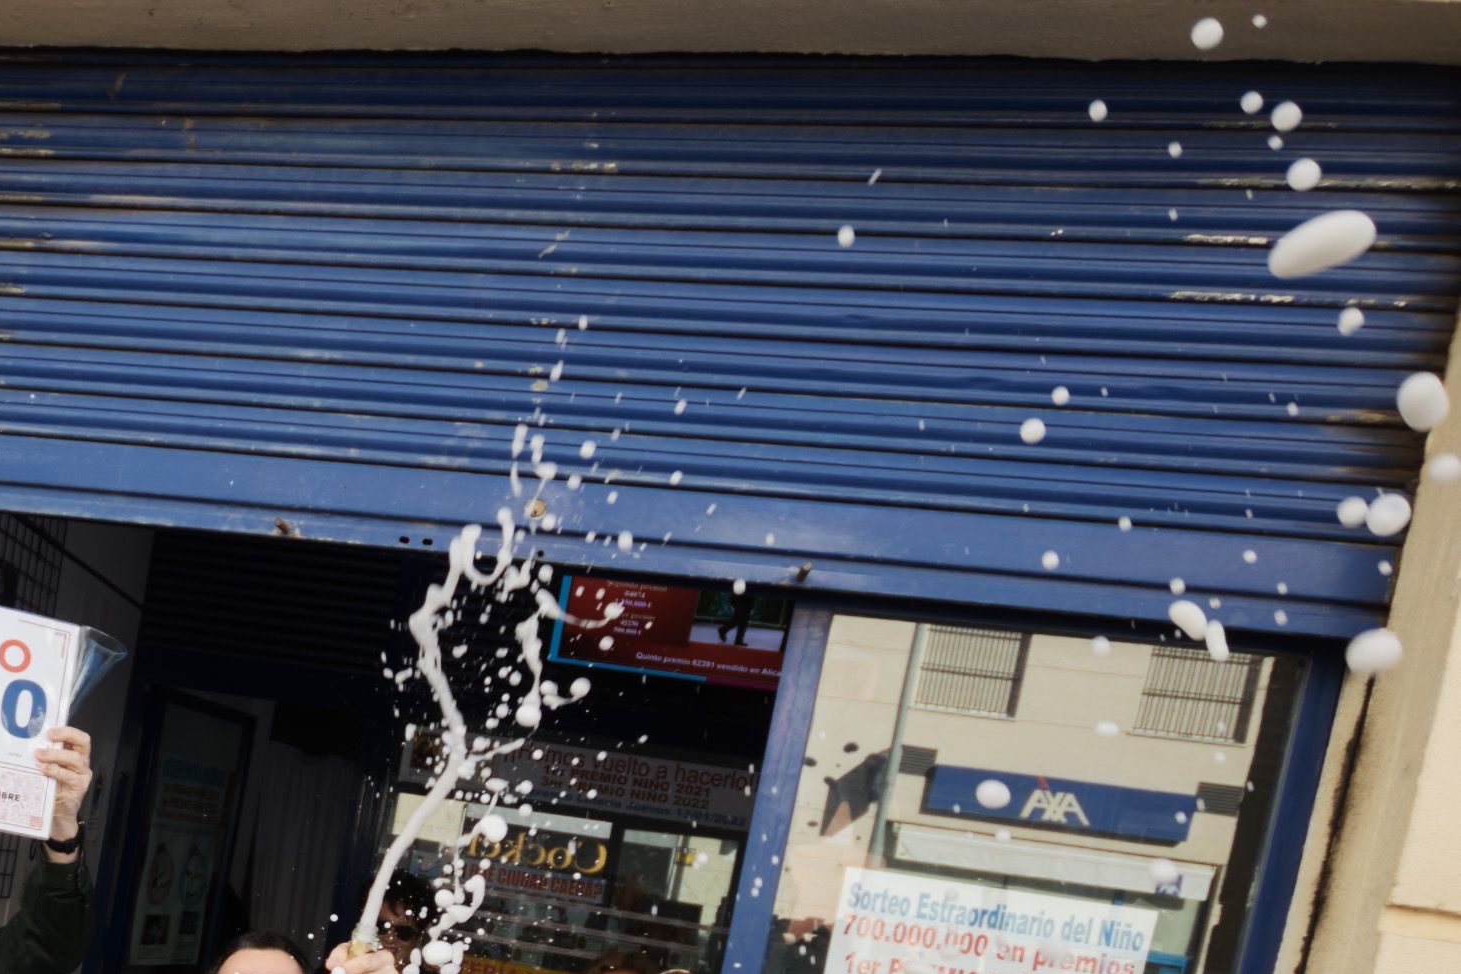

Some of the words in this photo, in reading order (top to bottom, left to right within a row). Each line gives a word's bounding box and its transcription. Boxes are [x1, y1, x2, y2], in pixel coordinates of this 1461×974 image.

[848, 882, 913, 920] Sorteo
[915, 892, 1055, 941] Estraordinario
[1061, 914, 1093, 946] del
[1099, 919, 1145, 953] Niño
